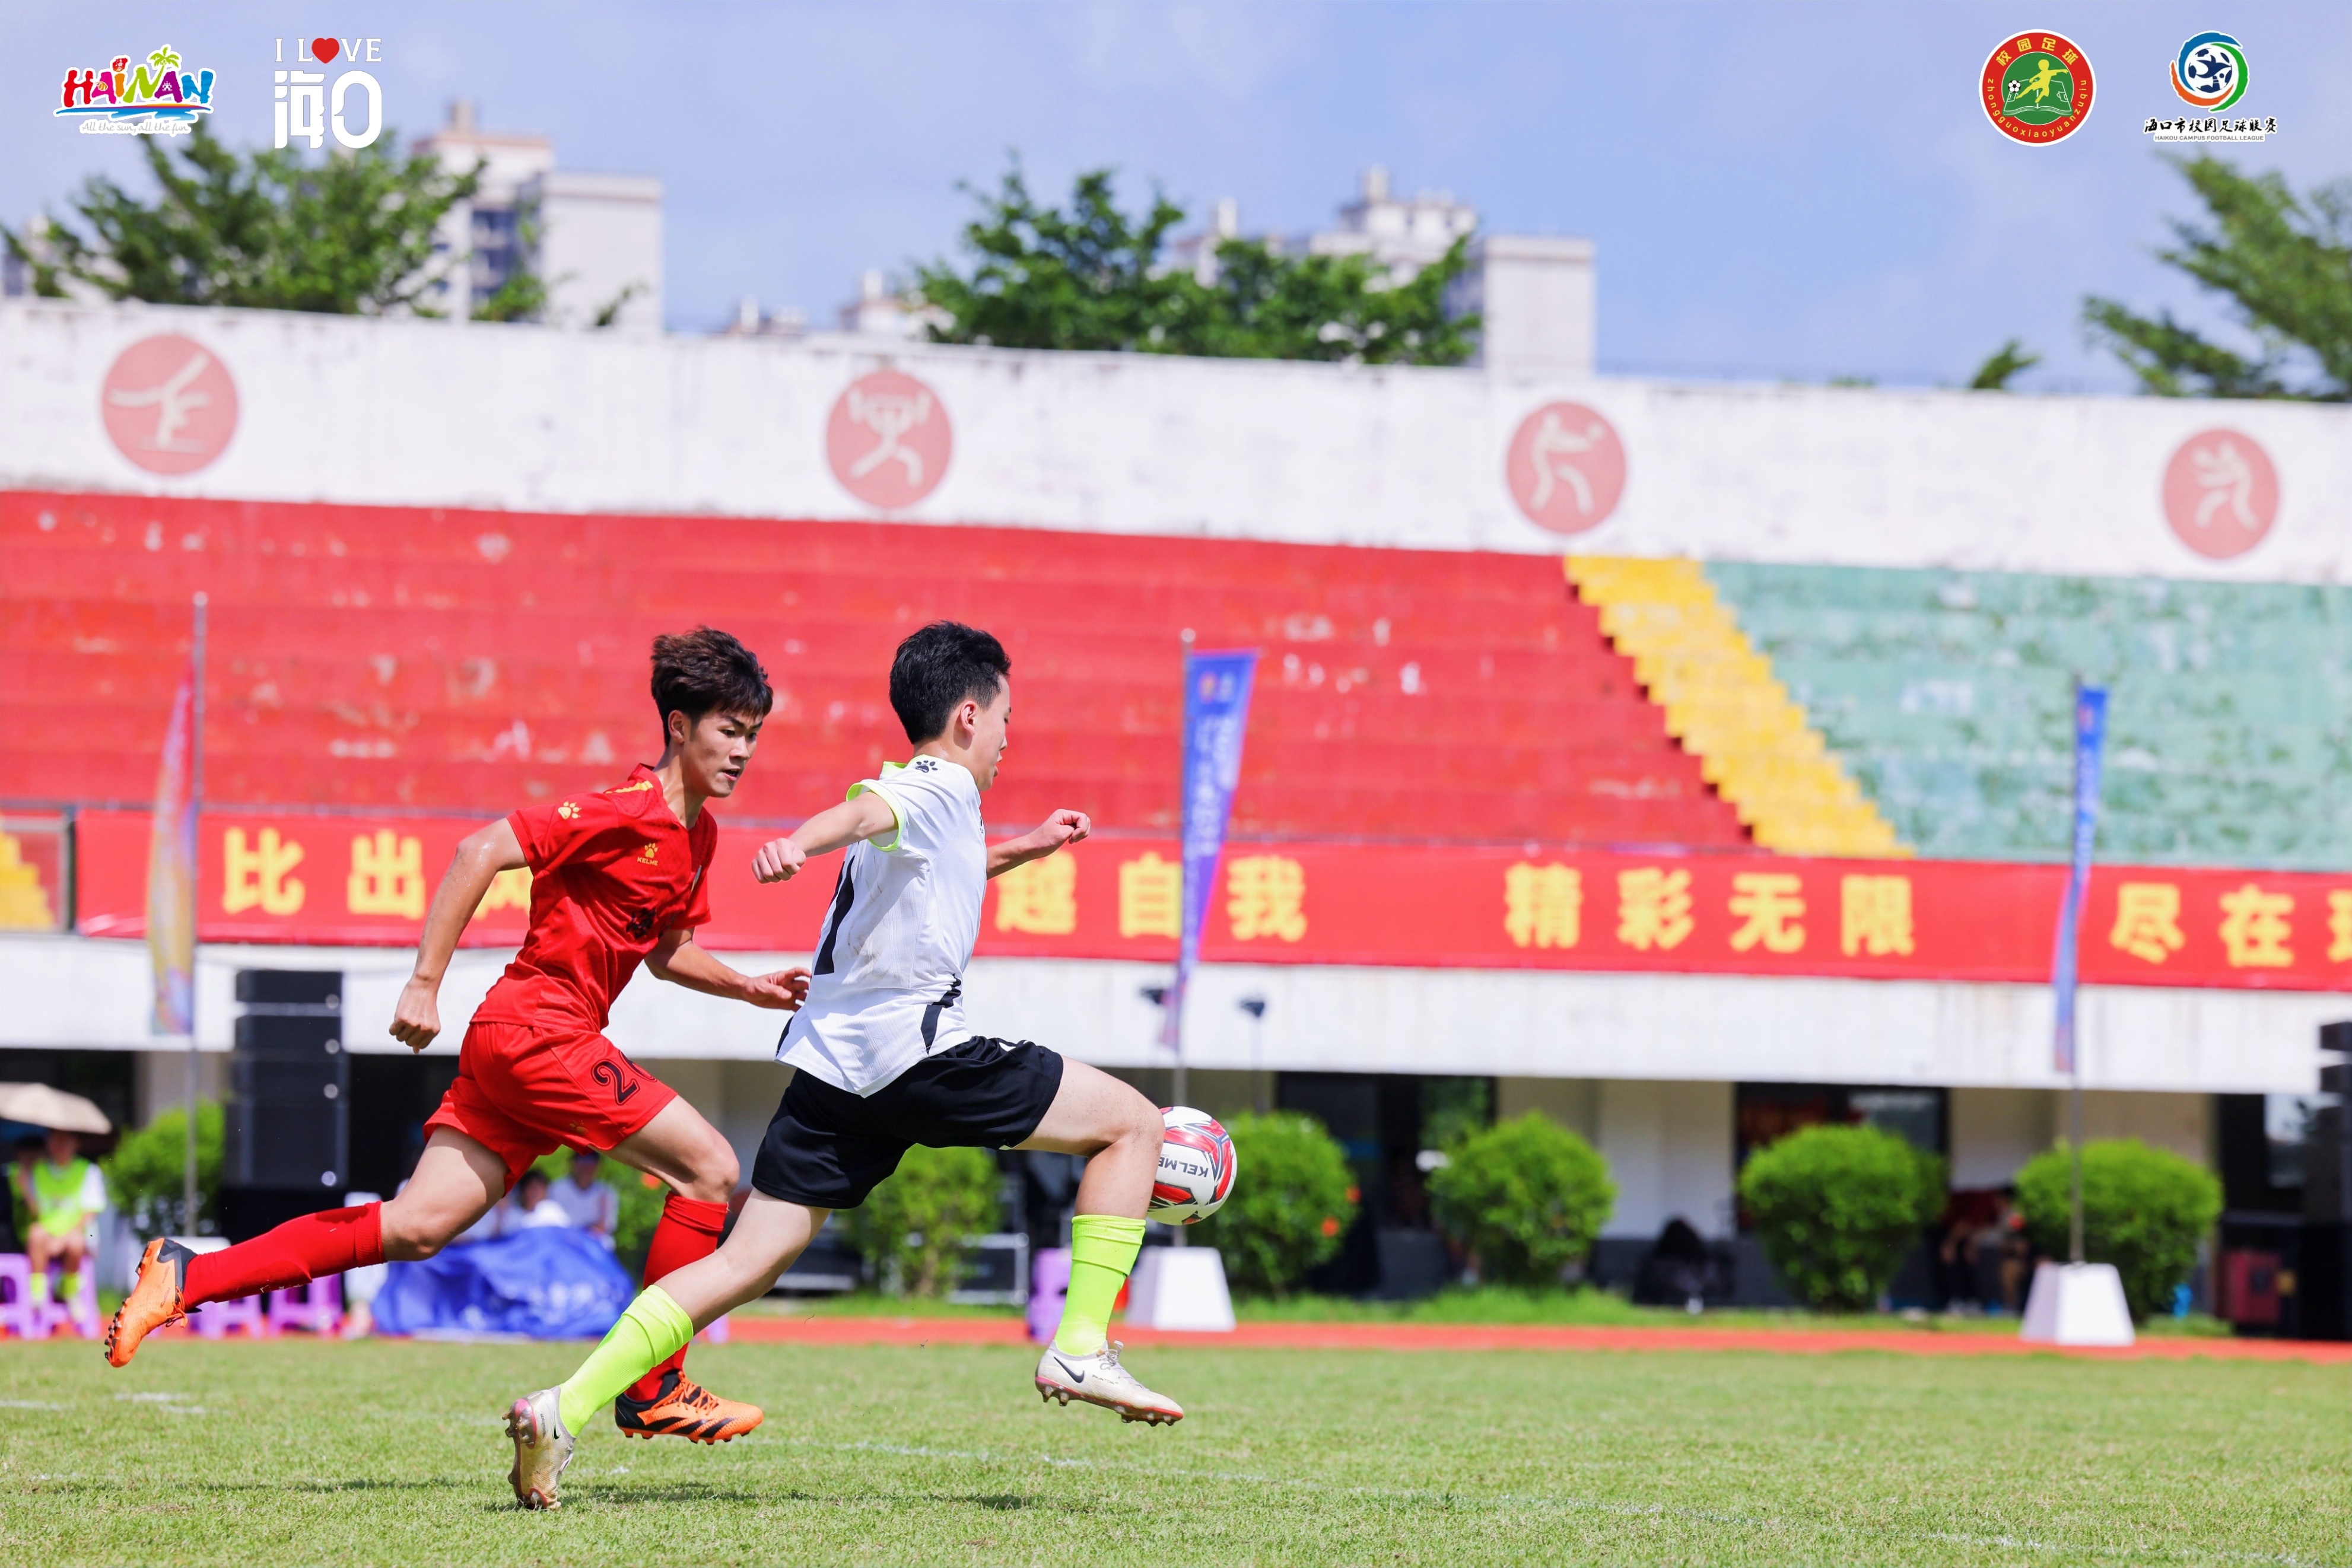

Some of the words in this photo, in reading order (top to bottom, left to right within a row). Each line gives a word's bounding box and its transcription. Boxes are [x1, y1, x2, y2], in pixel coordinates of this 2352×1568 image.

[637, 856, 659, 866] KELME
[1503, 861, 1917, 957] 精彩无限
[1158, 1156, 1209, 1178] KELME
